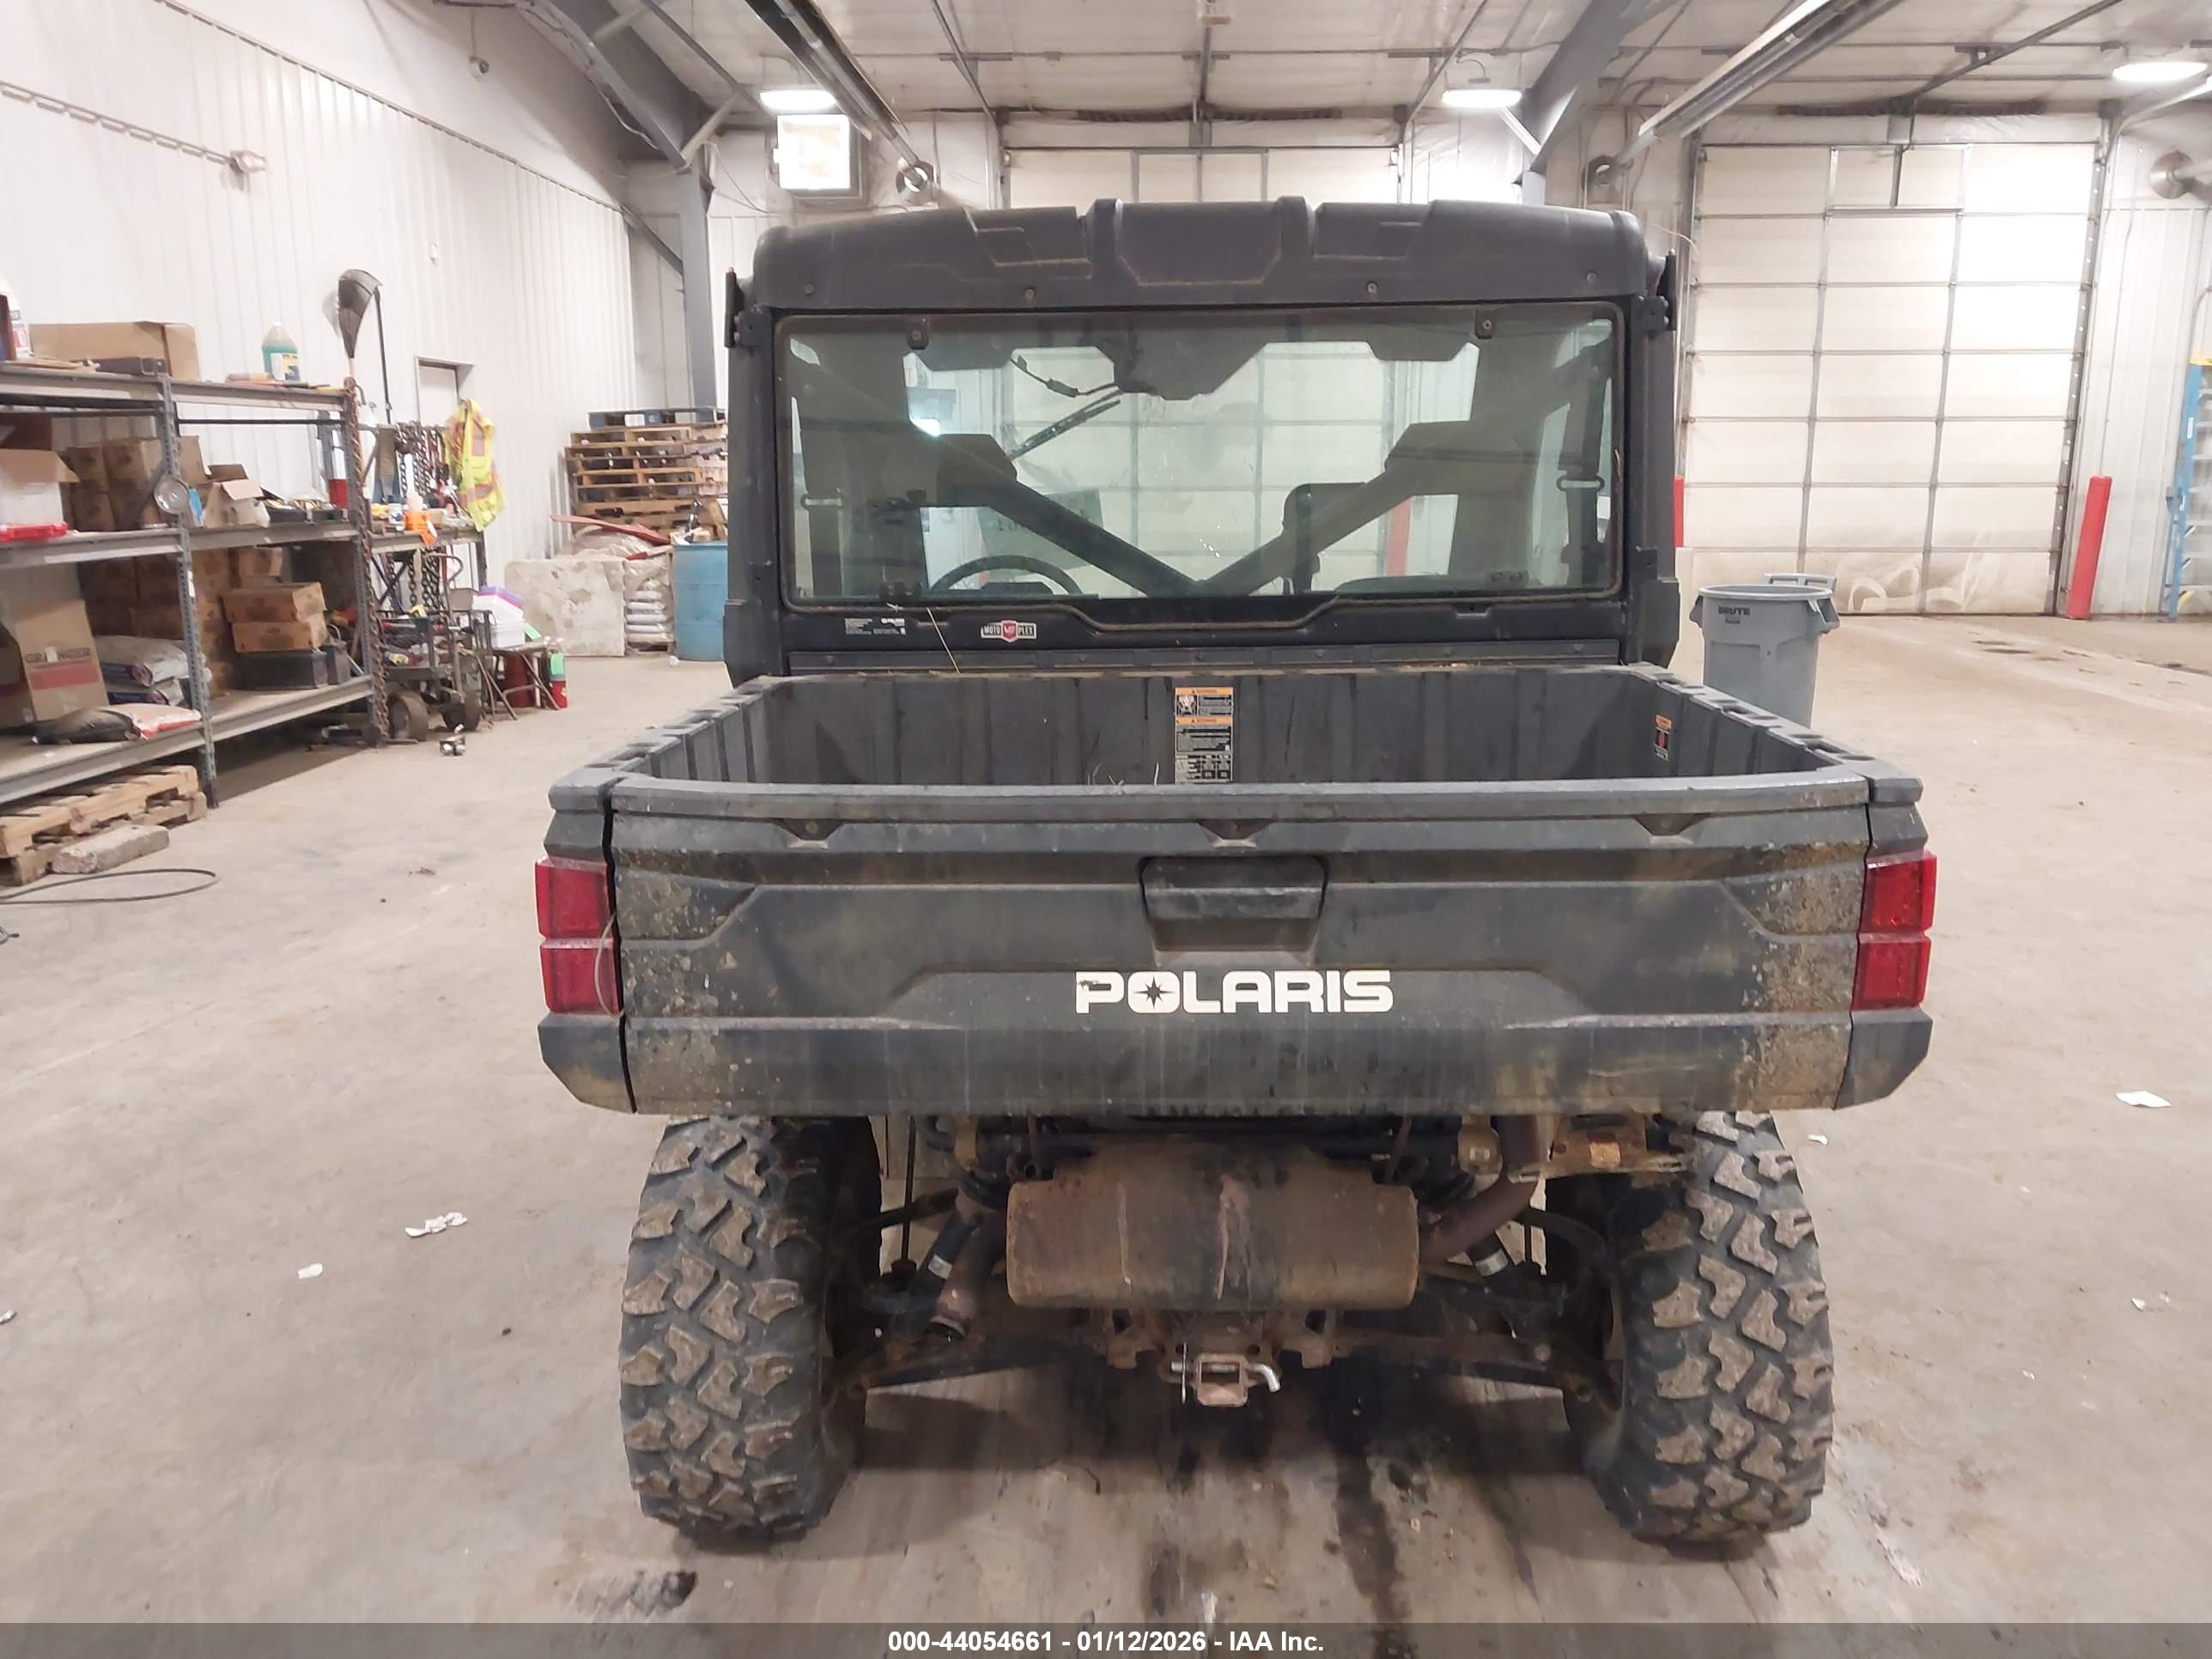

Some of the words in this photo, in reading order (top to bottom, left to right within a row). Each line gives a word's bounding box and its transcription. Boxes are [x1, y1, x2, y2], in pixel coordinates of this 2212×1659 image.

[984, 625, 1000, 635] MOTO
[1018, 626, 1033, 635] PLEX
[1075, 969, 1394, 1014] POLARIS
